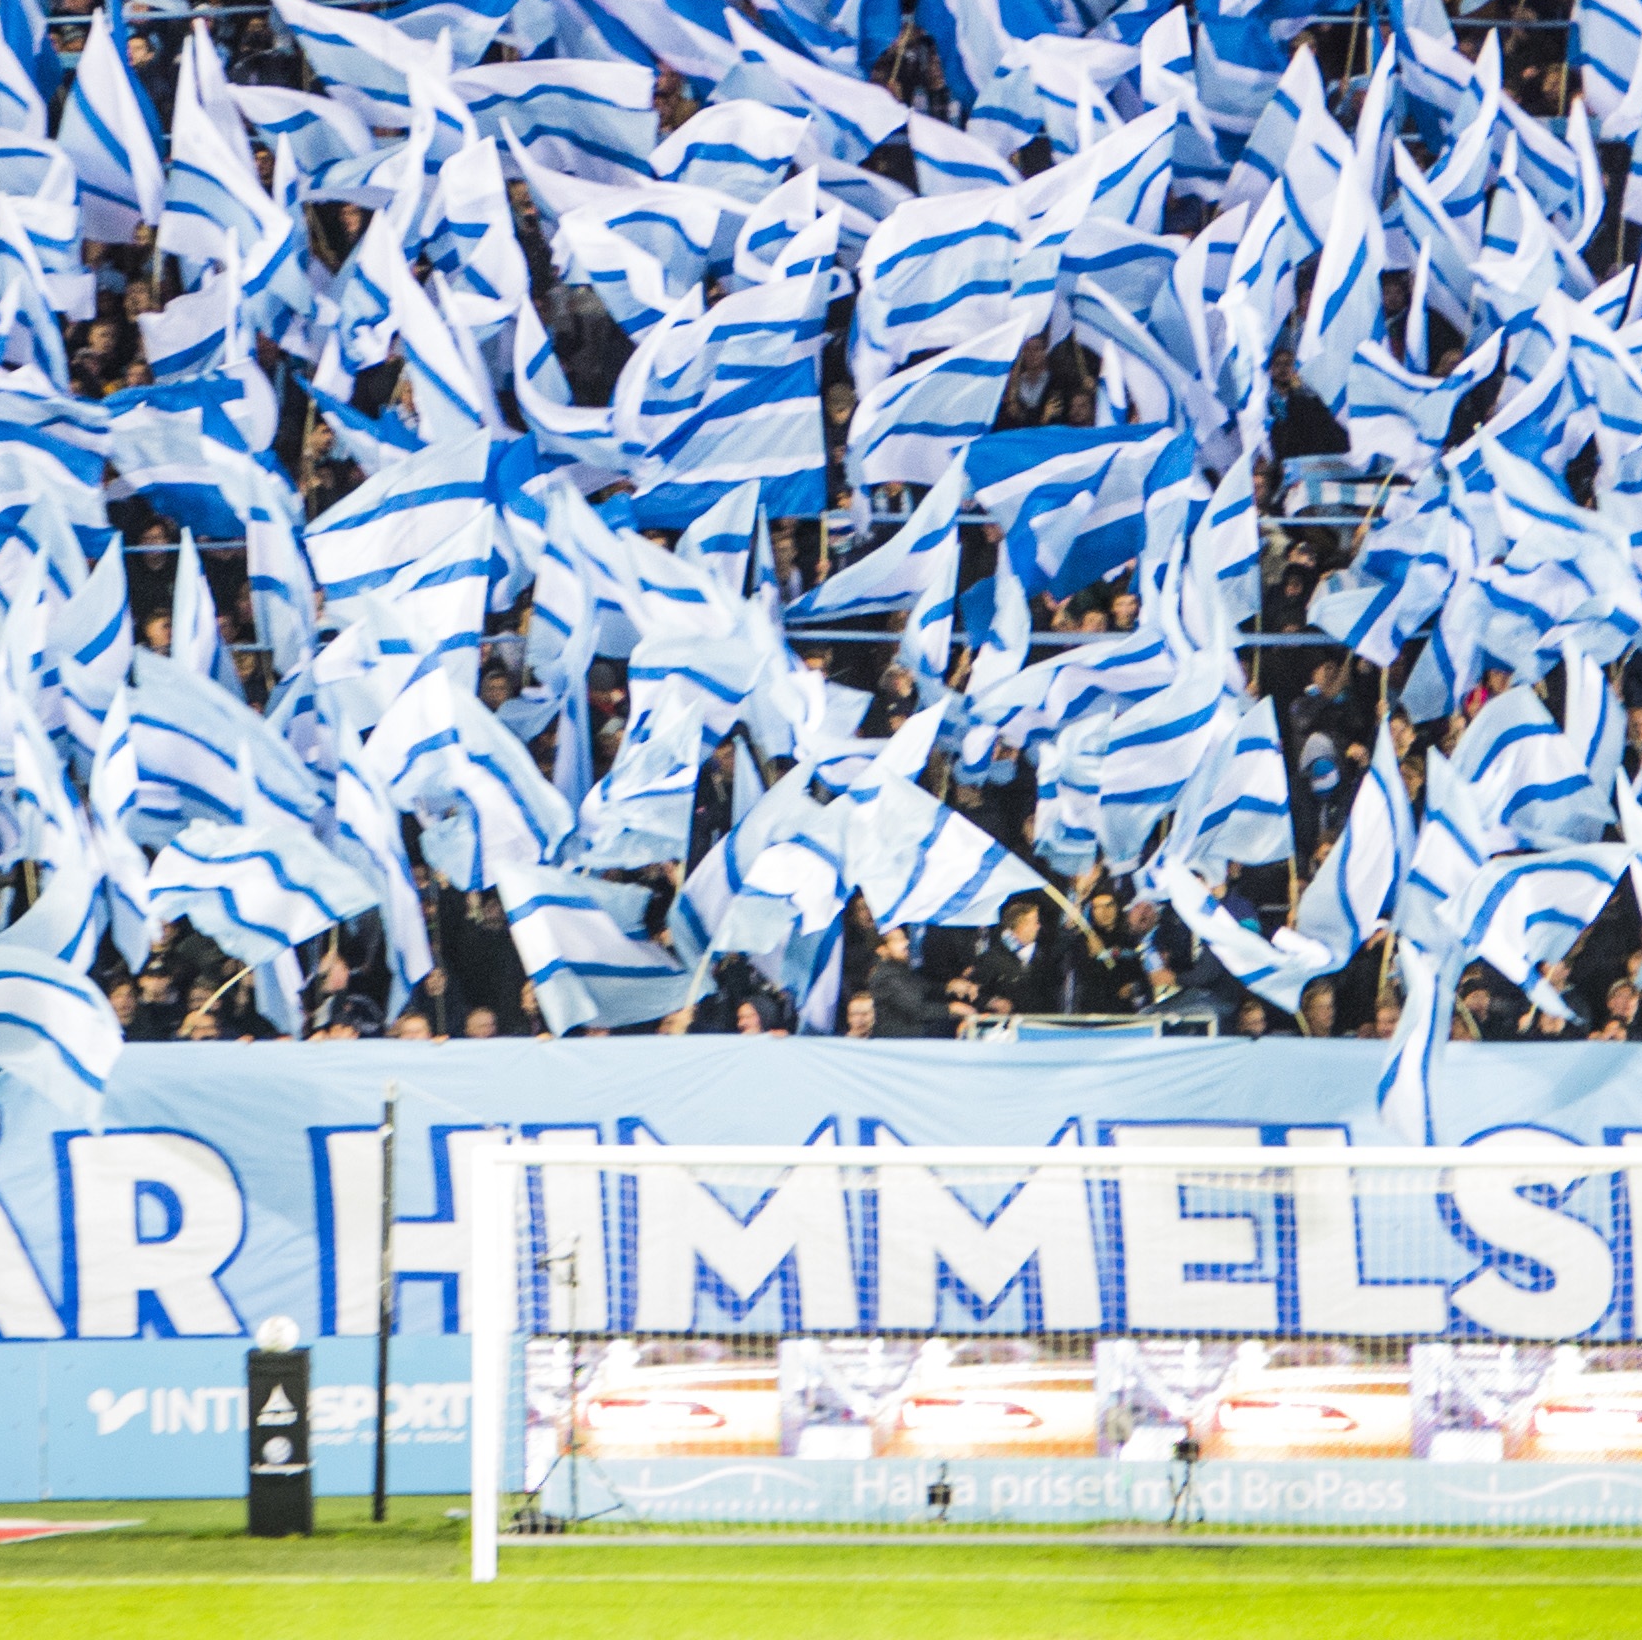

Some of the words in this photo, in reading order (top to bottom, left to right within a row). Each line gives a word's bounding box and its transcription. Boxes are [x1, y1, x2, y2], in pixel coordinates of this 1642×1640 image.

[150, 1381, 473, 1435] INTSPORT
[853, 1462, 978, 1508] Hala
[989, 1462, 1125, 1518] priset
[1131, 1465, 1233, 1512] md
[1242, 1468, 1408, 1513] BroPass
